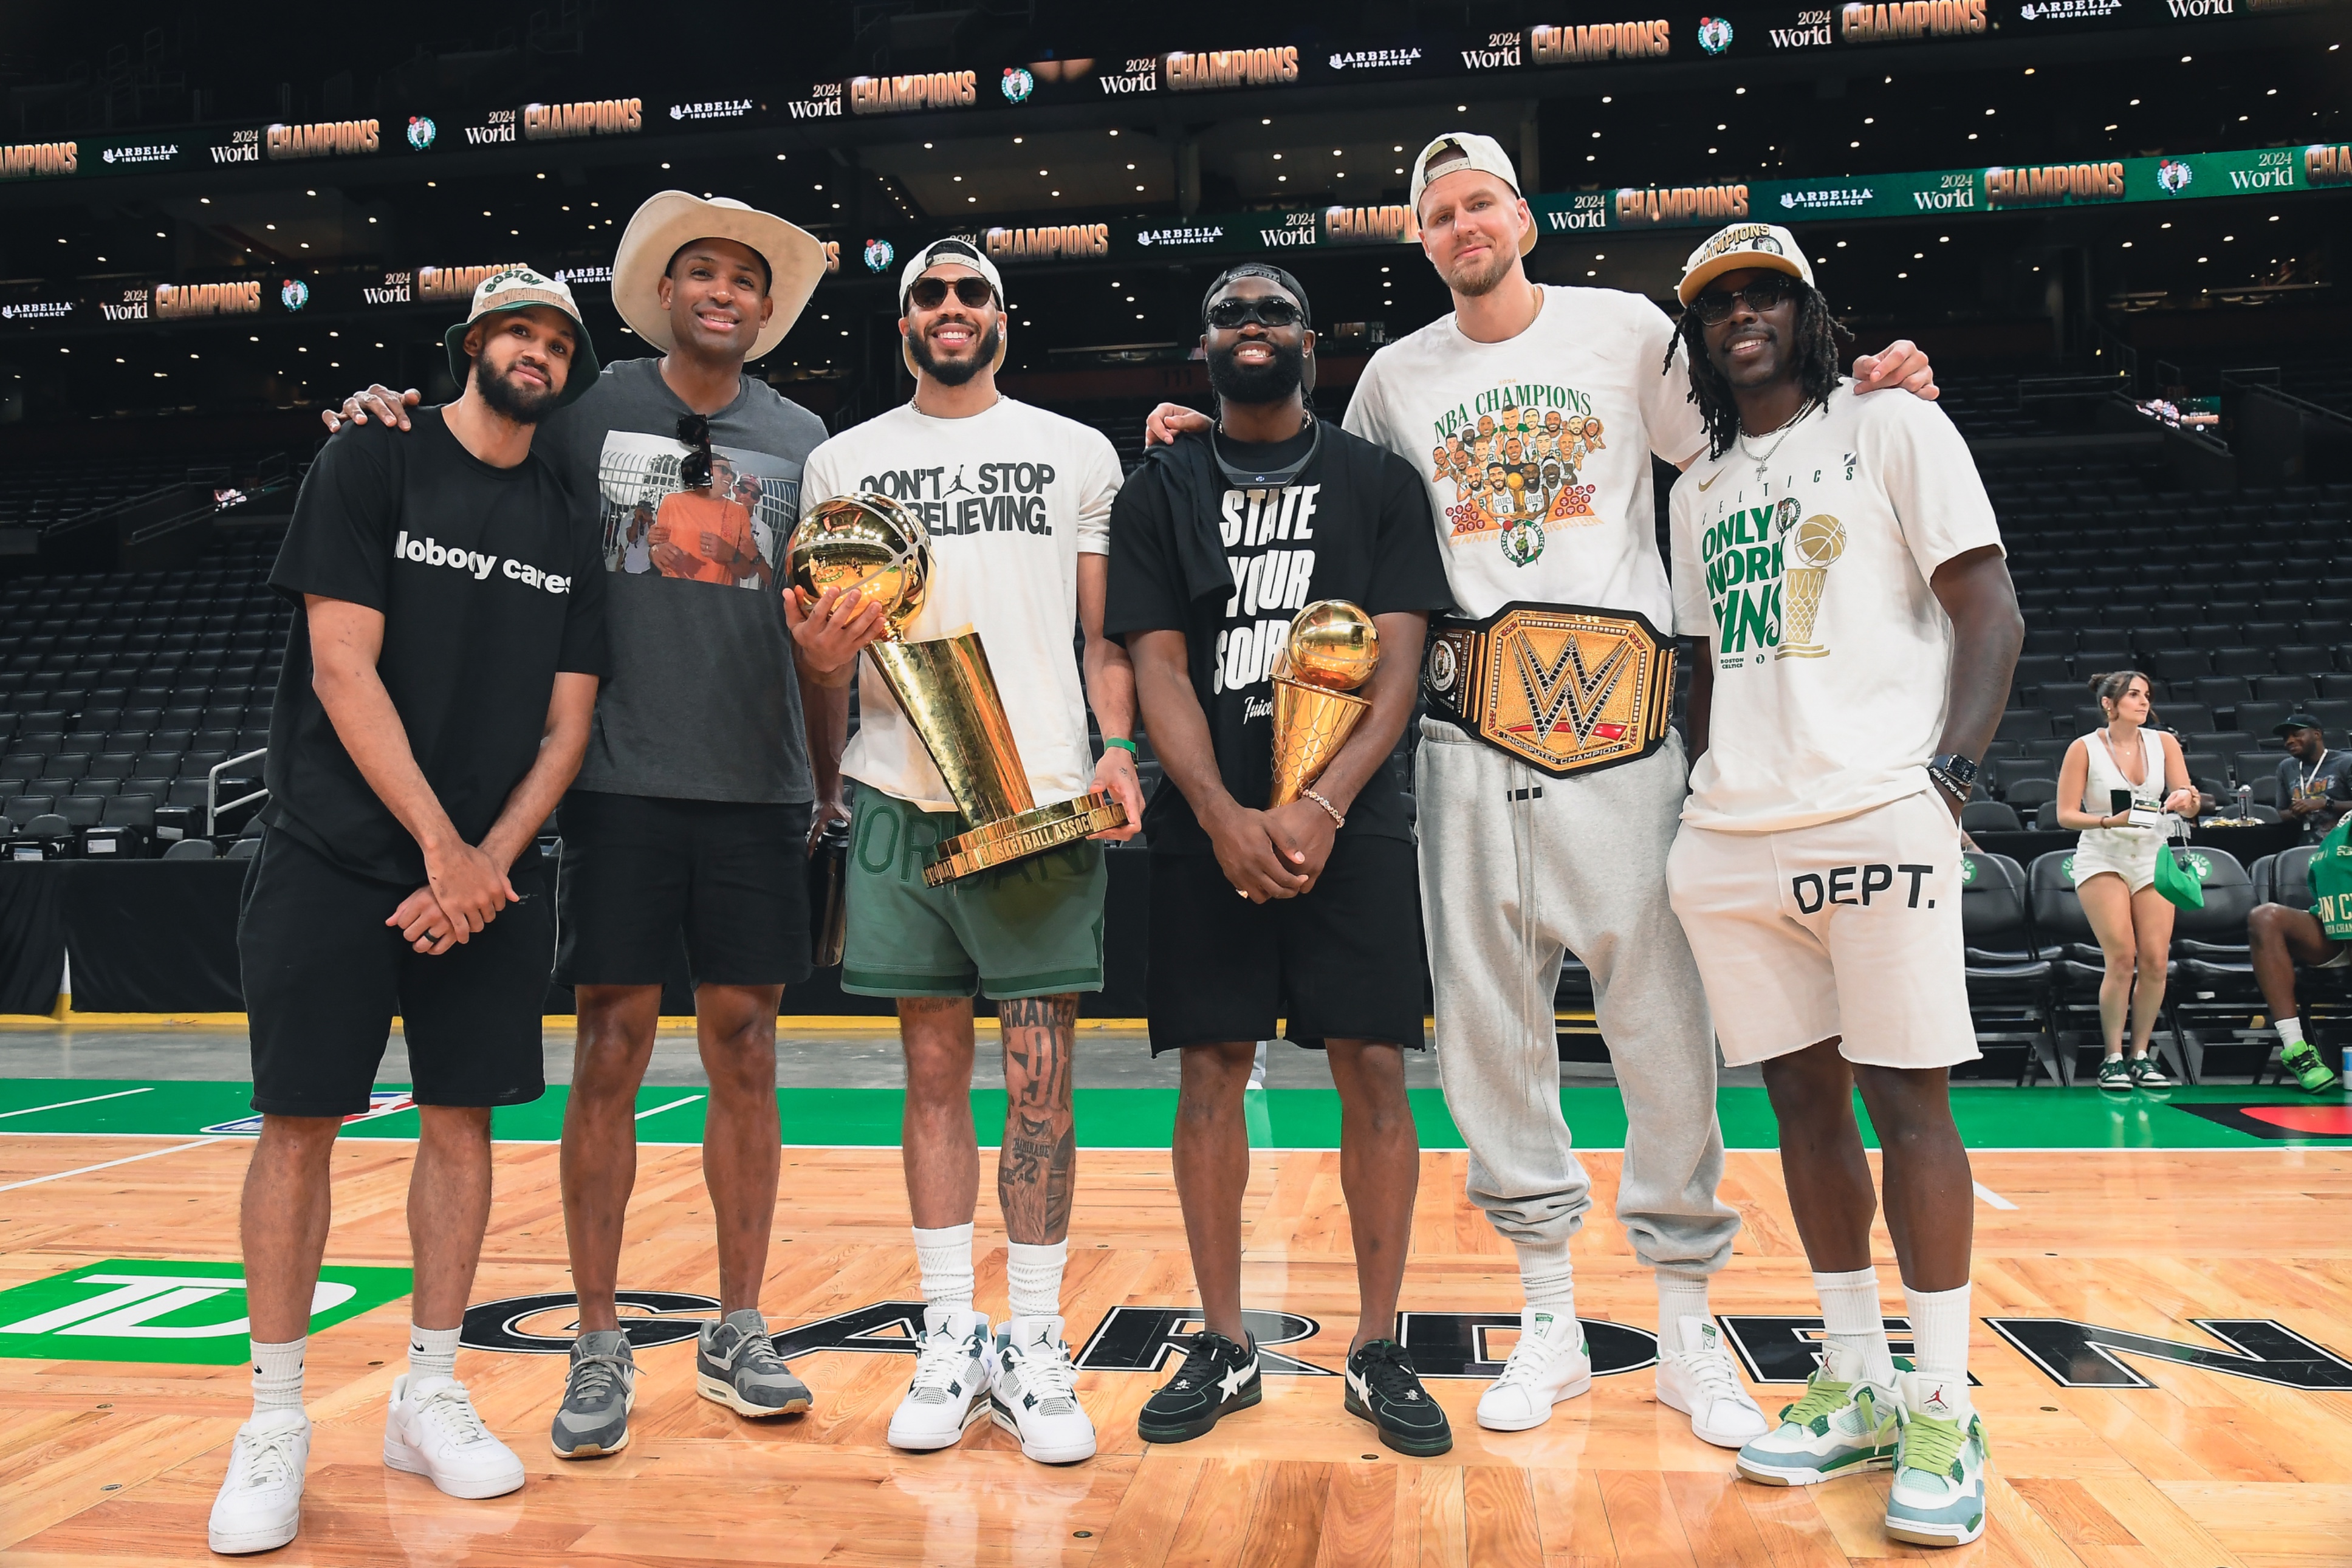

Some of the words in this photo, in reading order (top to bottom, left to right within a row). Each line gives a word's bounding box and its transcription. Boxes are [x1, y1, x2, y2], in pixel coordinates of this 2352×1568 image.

[2037, 0, 2122, 12] ARBELLA
[2046, 7, 2109, 19] INSURANCE
[1769, 25, 1831, 47] World
[1842, 0, 1987, 41] CHAMPIONS
[1798, 10, 1831, 25] 2024
[1461, 47, 1521, 69] World
[1531, 19, 1670, 61] CHAMPIONS
[1489, 32, 1520, 47] 2024
[1125, 58, 1156, 72] 2024
[1344, 48, 1421, 62] ARBELLA
[1353, 58, 1411, 68] INSURANCE
[1099, 72, 1156, 94] World
[1166, 46, 1298, 89] CHAMPIONS
[788, 97, 842, 118] World
[851, 70, 976, 113] CHAMPIONS
[812, 83, 842, 97] 2024
[682, 99, 752, 113] ARBELLA
[690, 110, 742, 119] INSURANCE
[465, 123, 515, 144] World
[524, 98, 642, 136] CHAMPIONS
[489, 111, 515, 123] 2024
[210, 143, 258, 163] World
[266, 120, 380, 156] CHAMPIONS
[232, 130, 258, 143] 2024
[114, 145, 178, 157] ARBELLA
[121, 153, 171, 162] INSURANCE
[2259, 152, 2292, 166] 2024
[2229, 166, 2293, 188] World
[2305, 146, 2352, 181] CHA
[1913, 188, 1974, 209] World
[1984, 162, 2124, 205] CHAMPIONS
[1941, 174, 1973, 188] 2024
[1574, 195, 1605, 208] 2024
[1794, 188, 1873, 202] ARBELLA
[1805, 197, 1863, 207] INSURANCE
[1548, 208, 1606, 230] World
[1616, 185, 1748, 221] CHAMPIONS
[1286, 213, 1315, 226] 2024
[986, 225, 1108, 260] CHAMPIONS
[1150, 227, 1222, 239] ARBELLA
[1159, 237, 1214, 245] INSURANCE
[1260, 226, 1315, 247] World
[1704, 228, 1727, 252] NBA
[1694, 224, 1769, 267] AMPIONS
[363, 285, 410, 304] World
[419, 263, 528, 299] CHAMP
[385, 273, 410, 285] 2024
[485, 270, 544, 293] BOSTON
[567, 267, 612, 279] ARBEL
[102, 302, 148, 320] World
[156, 281, 261, 317] CHAMPIONS
[123, 290, 148, 301] 2024
[13, 302, 72, 313] ARBELLA
[1433, 402, 1469, 443] NBA
[1475, 385, 1591, 416] CHAMPIONS
[978, 462, 1055, 495] STOP
[1219, 484, 1321, 547] STATE
[1502, 505, 1509, 513] 0
[1532, 504, 1538, 512] 7
[1501, 530, 1513, 558] BOSTON
[1530, 523, 1545, 550] CELTICS
[1702, 504, 1775, 564] ONLY
[1706, 535, 1786, 601] WORK
[1225, 549, 1316, 618] YOUR
[1243, 696, 1274, 725] Juice
[1503, 734, 1557, 764] UNDISPUTED
[1560, 745, 1620, 765] CHAMPION
[982, 825, 1054, 865] BASKETBALL
[1792, 863, 1935, 914] DEPT.
[1013, 1152, 1038, 1185] 22
[458, 1290, 2352, 1392] GARDEN
